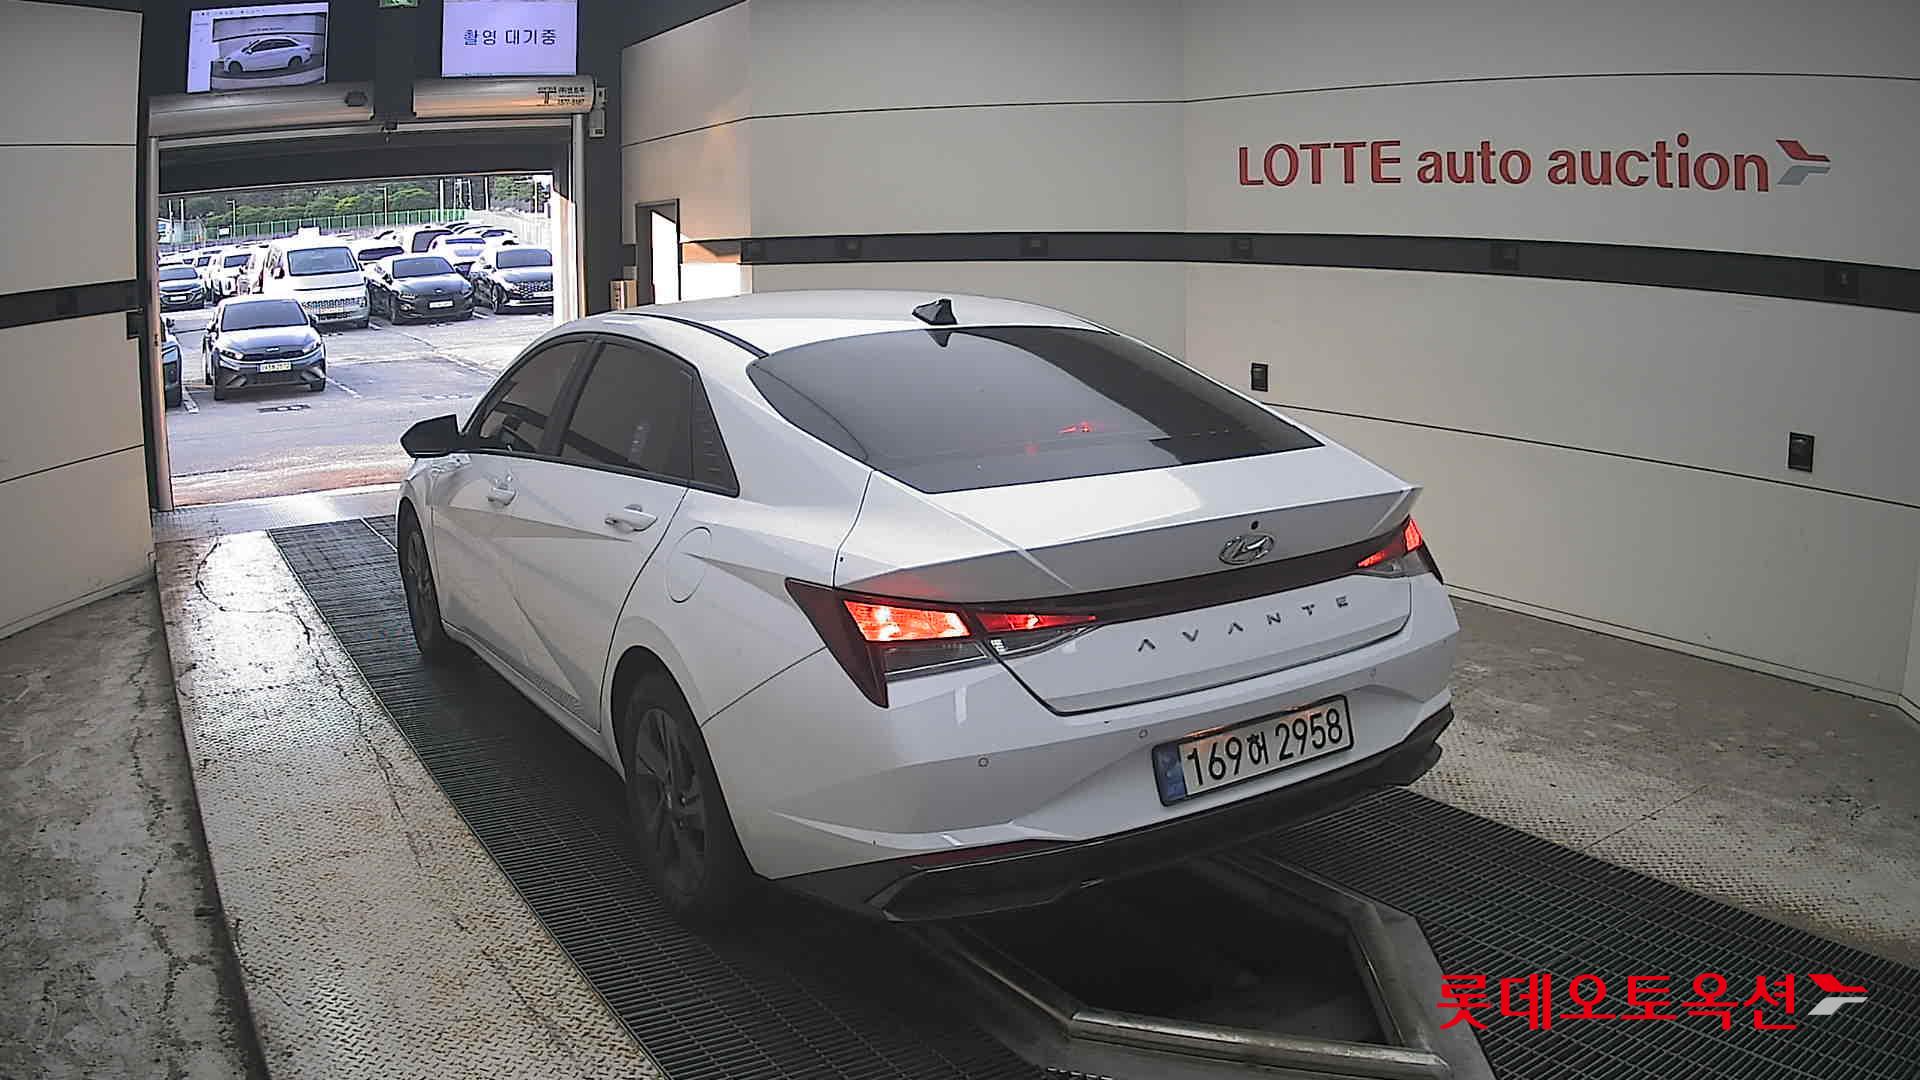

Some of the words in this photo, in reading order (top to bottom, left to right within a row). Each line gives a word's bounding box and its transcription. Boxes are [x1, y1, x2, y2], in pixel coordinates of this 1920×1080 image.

[463, 29, 497, 46] 촬영
[505, 29, 556, 46] 대기중
[1239, 140, 1401, 187] LOTTE
[1416, 140, 1532, 186] auto
[1547, 132, 1769, 192] auction
[1137, 595, 1350, 653] AVANTE
[1186, 731, 1270, 787] 169허
[1274, 707, 1344, 762] 2958
